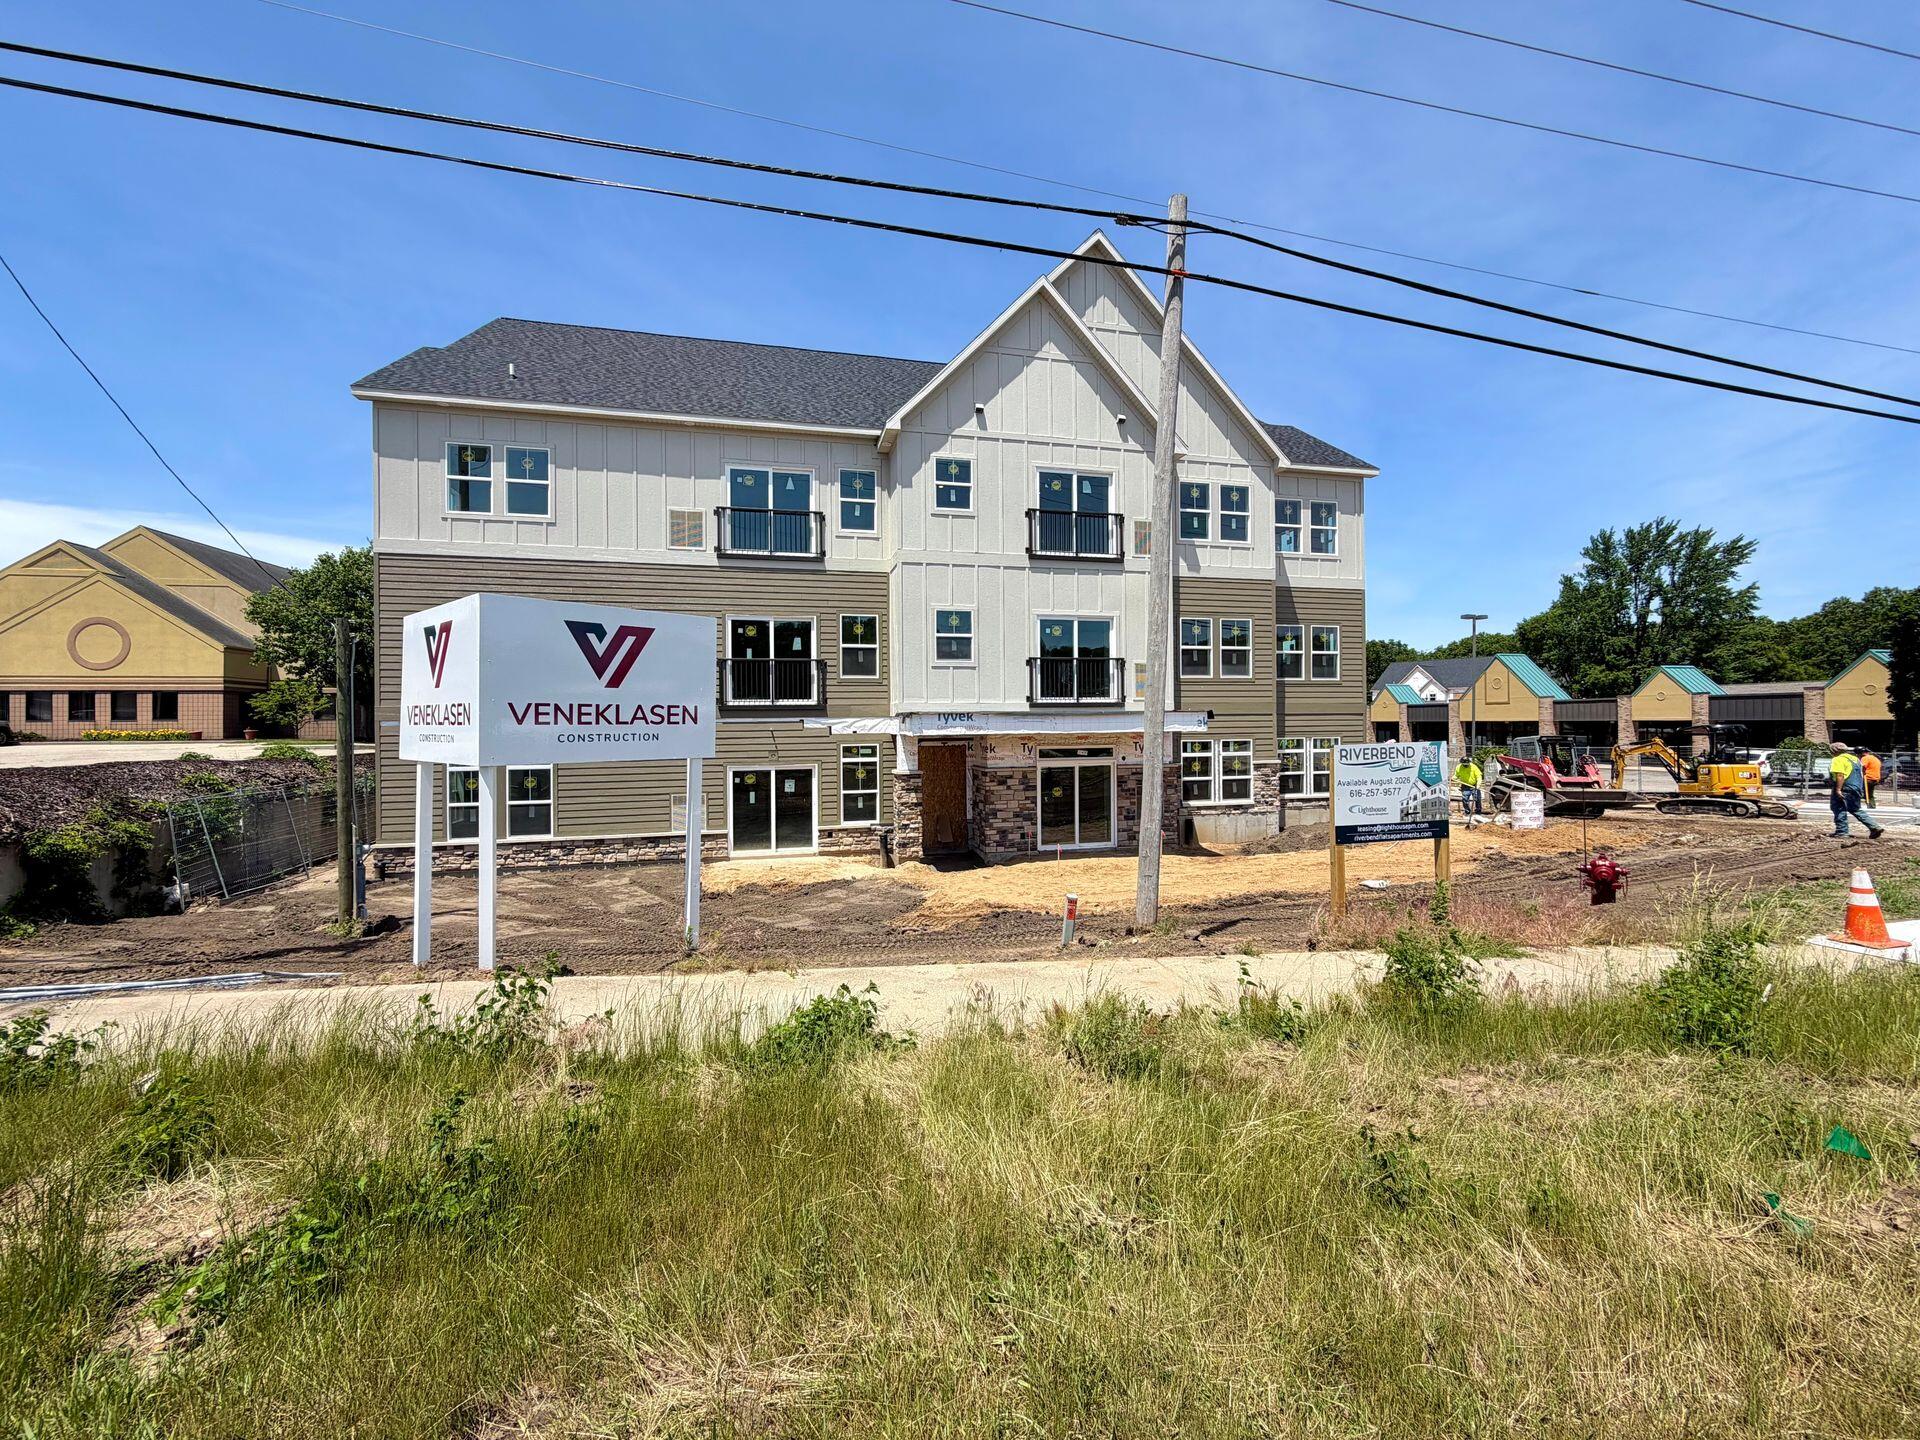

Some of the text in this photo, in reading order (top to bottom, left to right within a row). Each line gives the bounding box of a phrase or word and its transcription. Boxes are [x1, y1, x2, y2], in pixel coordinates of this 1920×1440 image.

[407, 703, 471, 726] VENEKLASEN
[507, 702, 698, 726] VENEKLASEN
[419, 733, 455, 743] CONSTRUCTION
[557, 733, 660, 743] CONSTRUCTION
[1339, 746, 1415, 761] RIVERBEND
[1337, 779, 1368, 787] Available
[1370, 778, 1394, 786] August
[1349, 788, 1401, 798] 616-257-9577
[1357, 805, 1388, 815] Lighthouse
[1357, 822, 1429, 833] leasing@lighthousepm.com
[1354, 832, 1433, 842] riverbendflatsapartments.com
